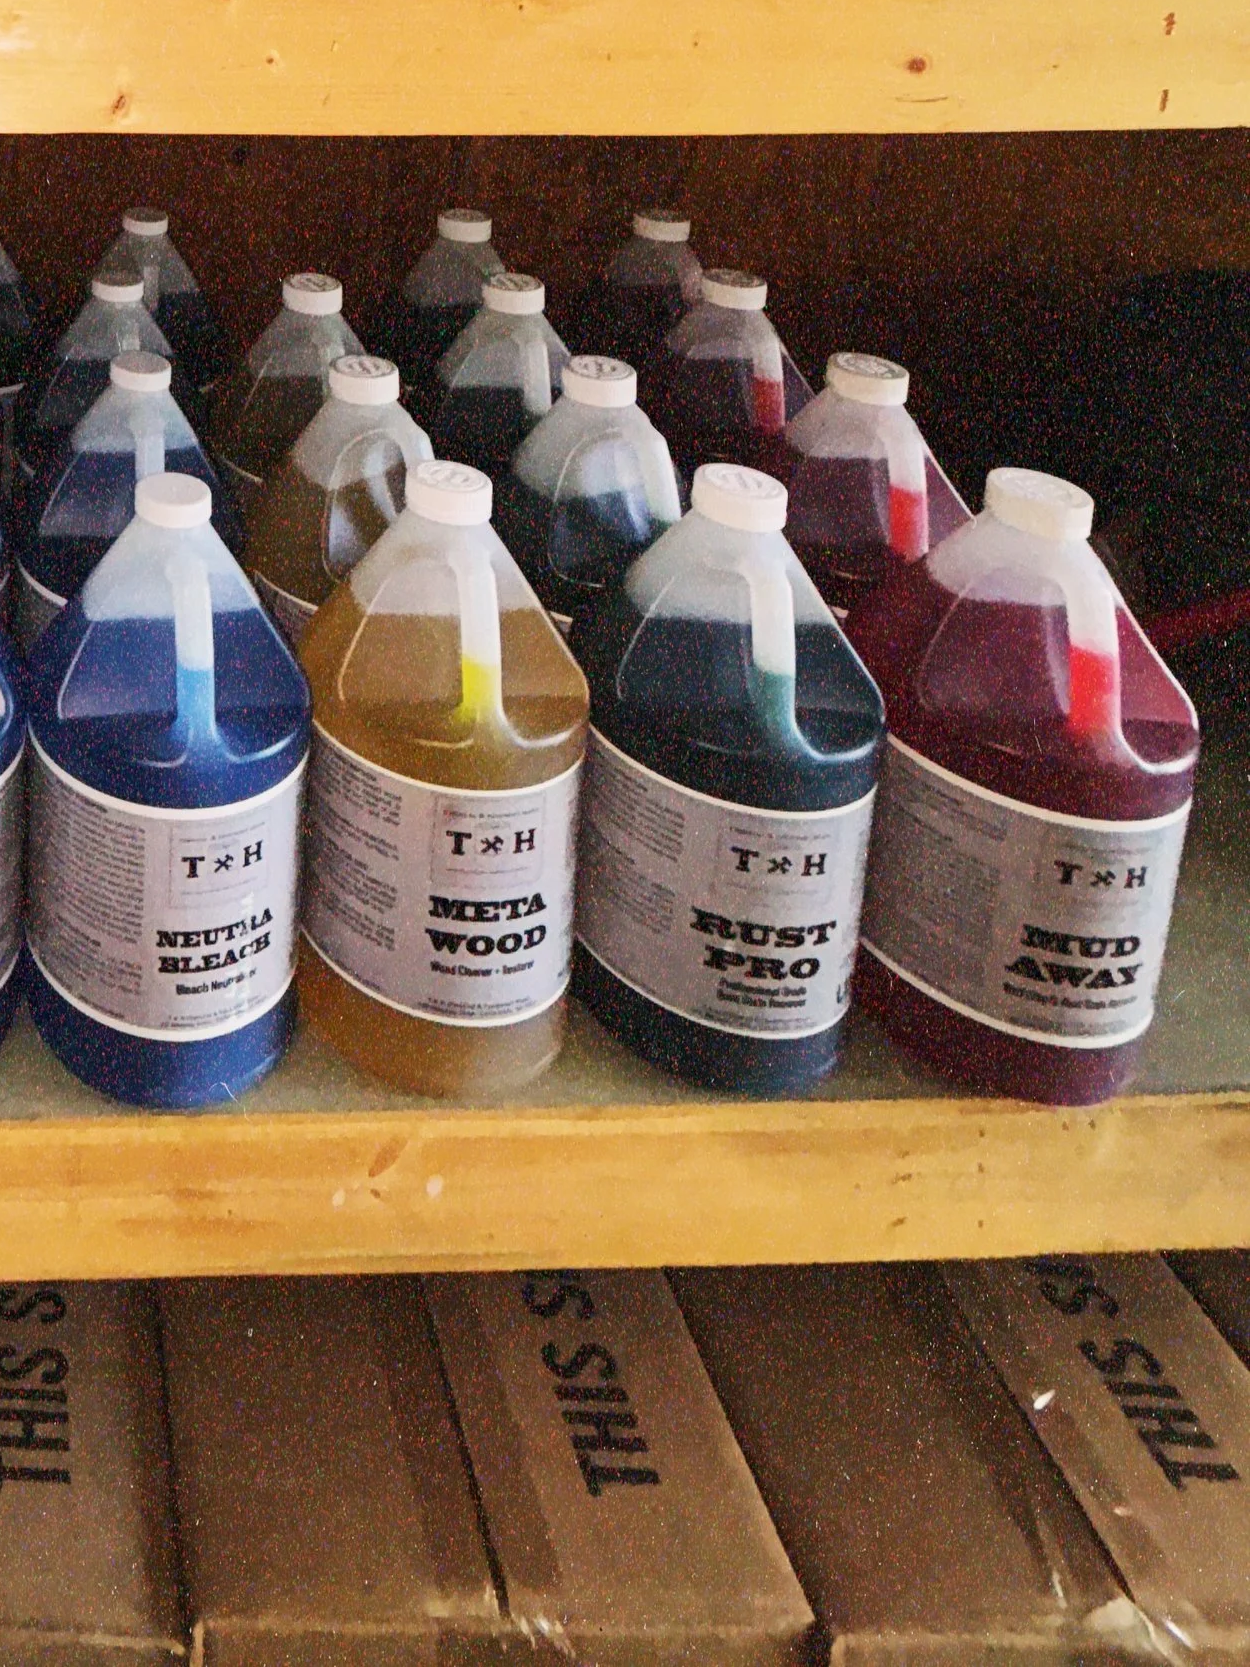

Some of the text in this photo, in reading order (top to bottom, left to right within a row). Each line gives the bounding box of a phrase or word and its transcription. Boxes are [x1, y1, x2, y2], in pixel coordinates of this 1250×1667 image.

[446, 828, 537, 856] T H
[181, 840, 263, 879] T H
[730, 846, 828, 877] T H
[1054, 860, 1149, 889] T H
[428, 892, 547, 923] META
[425, 925, 547, 956] WOOD
[690, 906, 837, 948] RUST
[1021, 924, 1141, 958] MUD
[158, 930, 271, 974] BLEACH
[703, 943, 821, 980] PRO
[1004, 955, 1143, 989] AWAY
[540, 1341, 661, 1498] THIS
[1077, 1337, 1242, 1490] THIS
